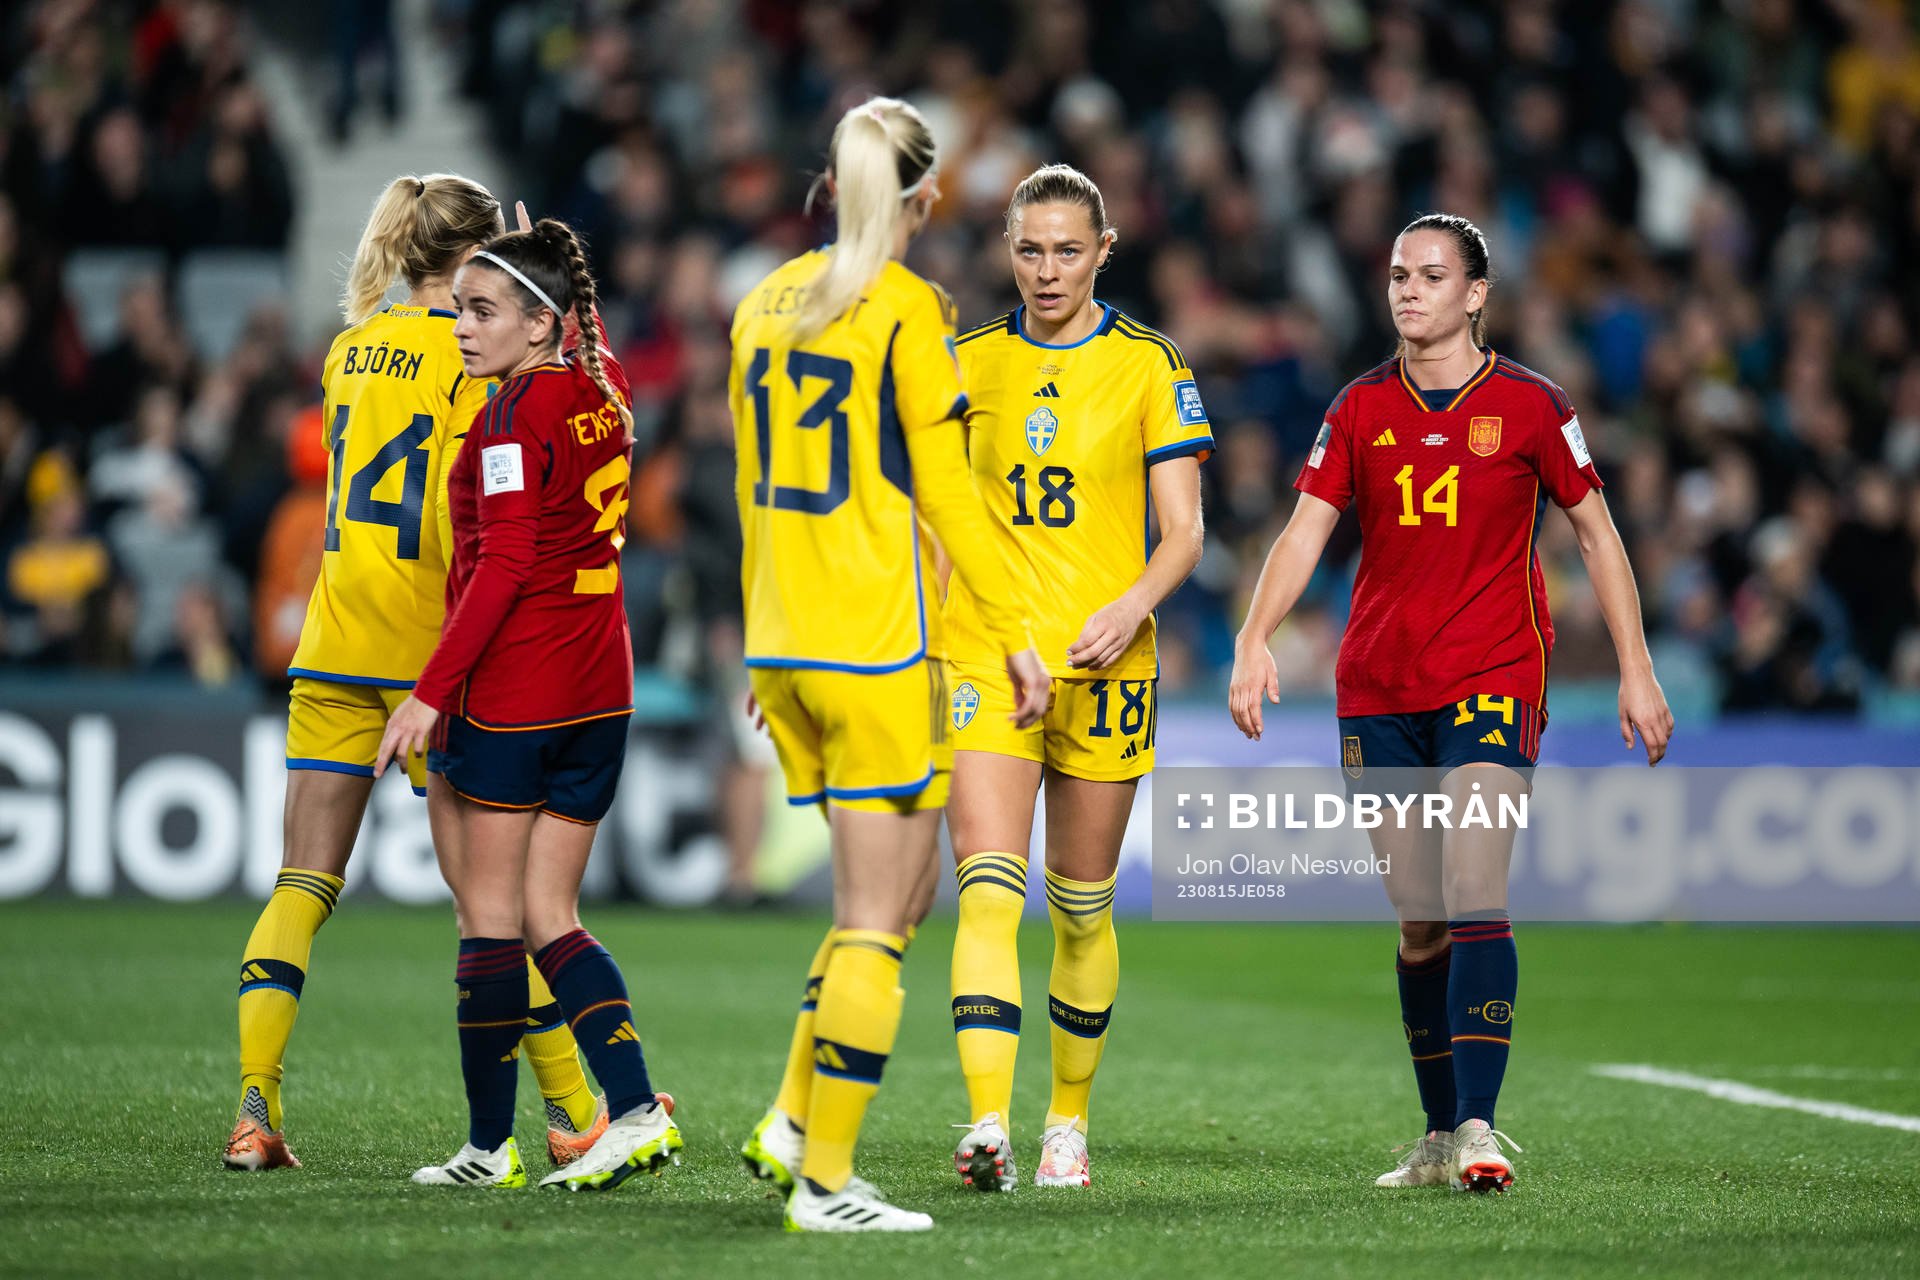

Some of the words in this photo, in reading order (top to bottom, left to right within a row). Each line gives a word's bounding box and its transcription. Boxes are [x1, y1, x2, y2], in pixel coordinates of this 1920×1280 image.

[344, 342, 424, 381] BJÖRN
[744, 348, 853, 516] 13
[324, 405, 434, 560] 14
[1006, 464, 1075, 528] 18
[1393, 465, 1459, 527] 14
[1088, 680, 1147, 738] 18
[1051, 1002, 1104, 1026] SVERIGE
